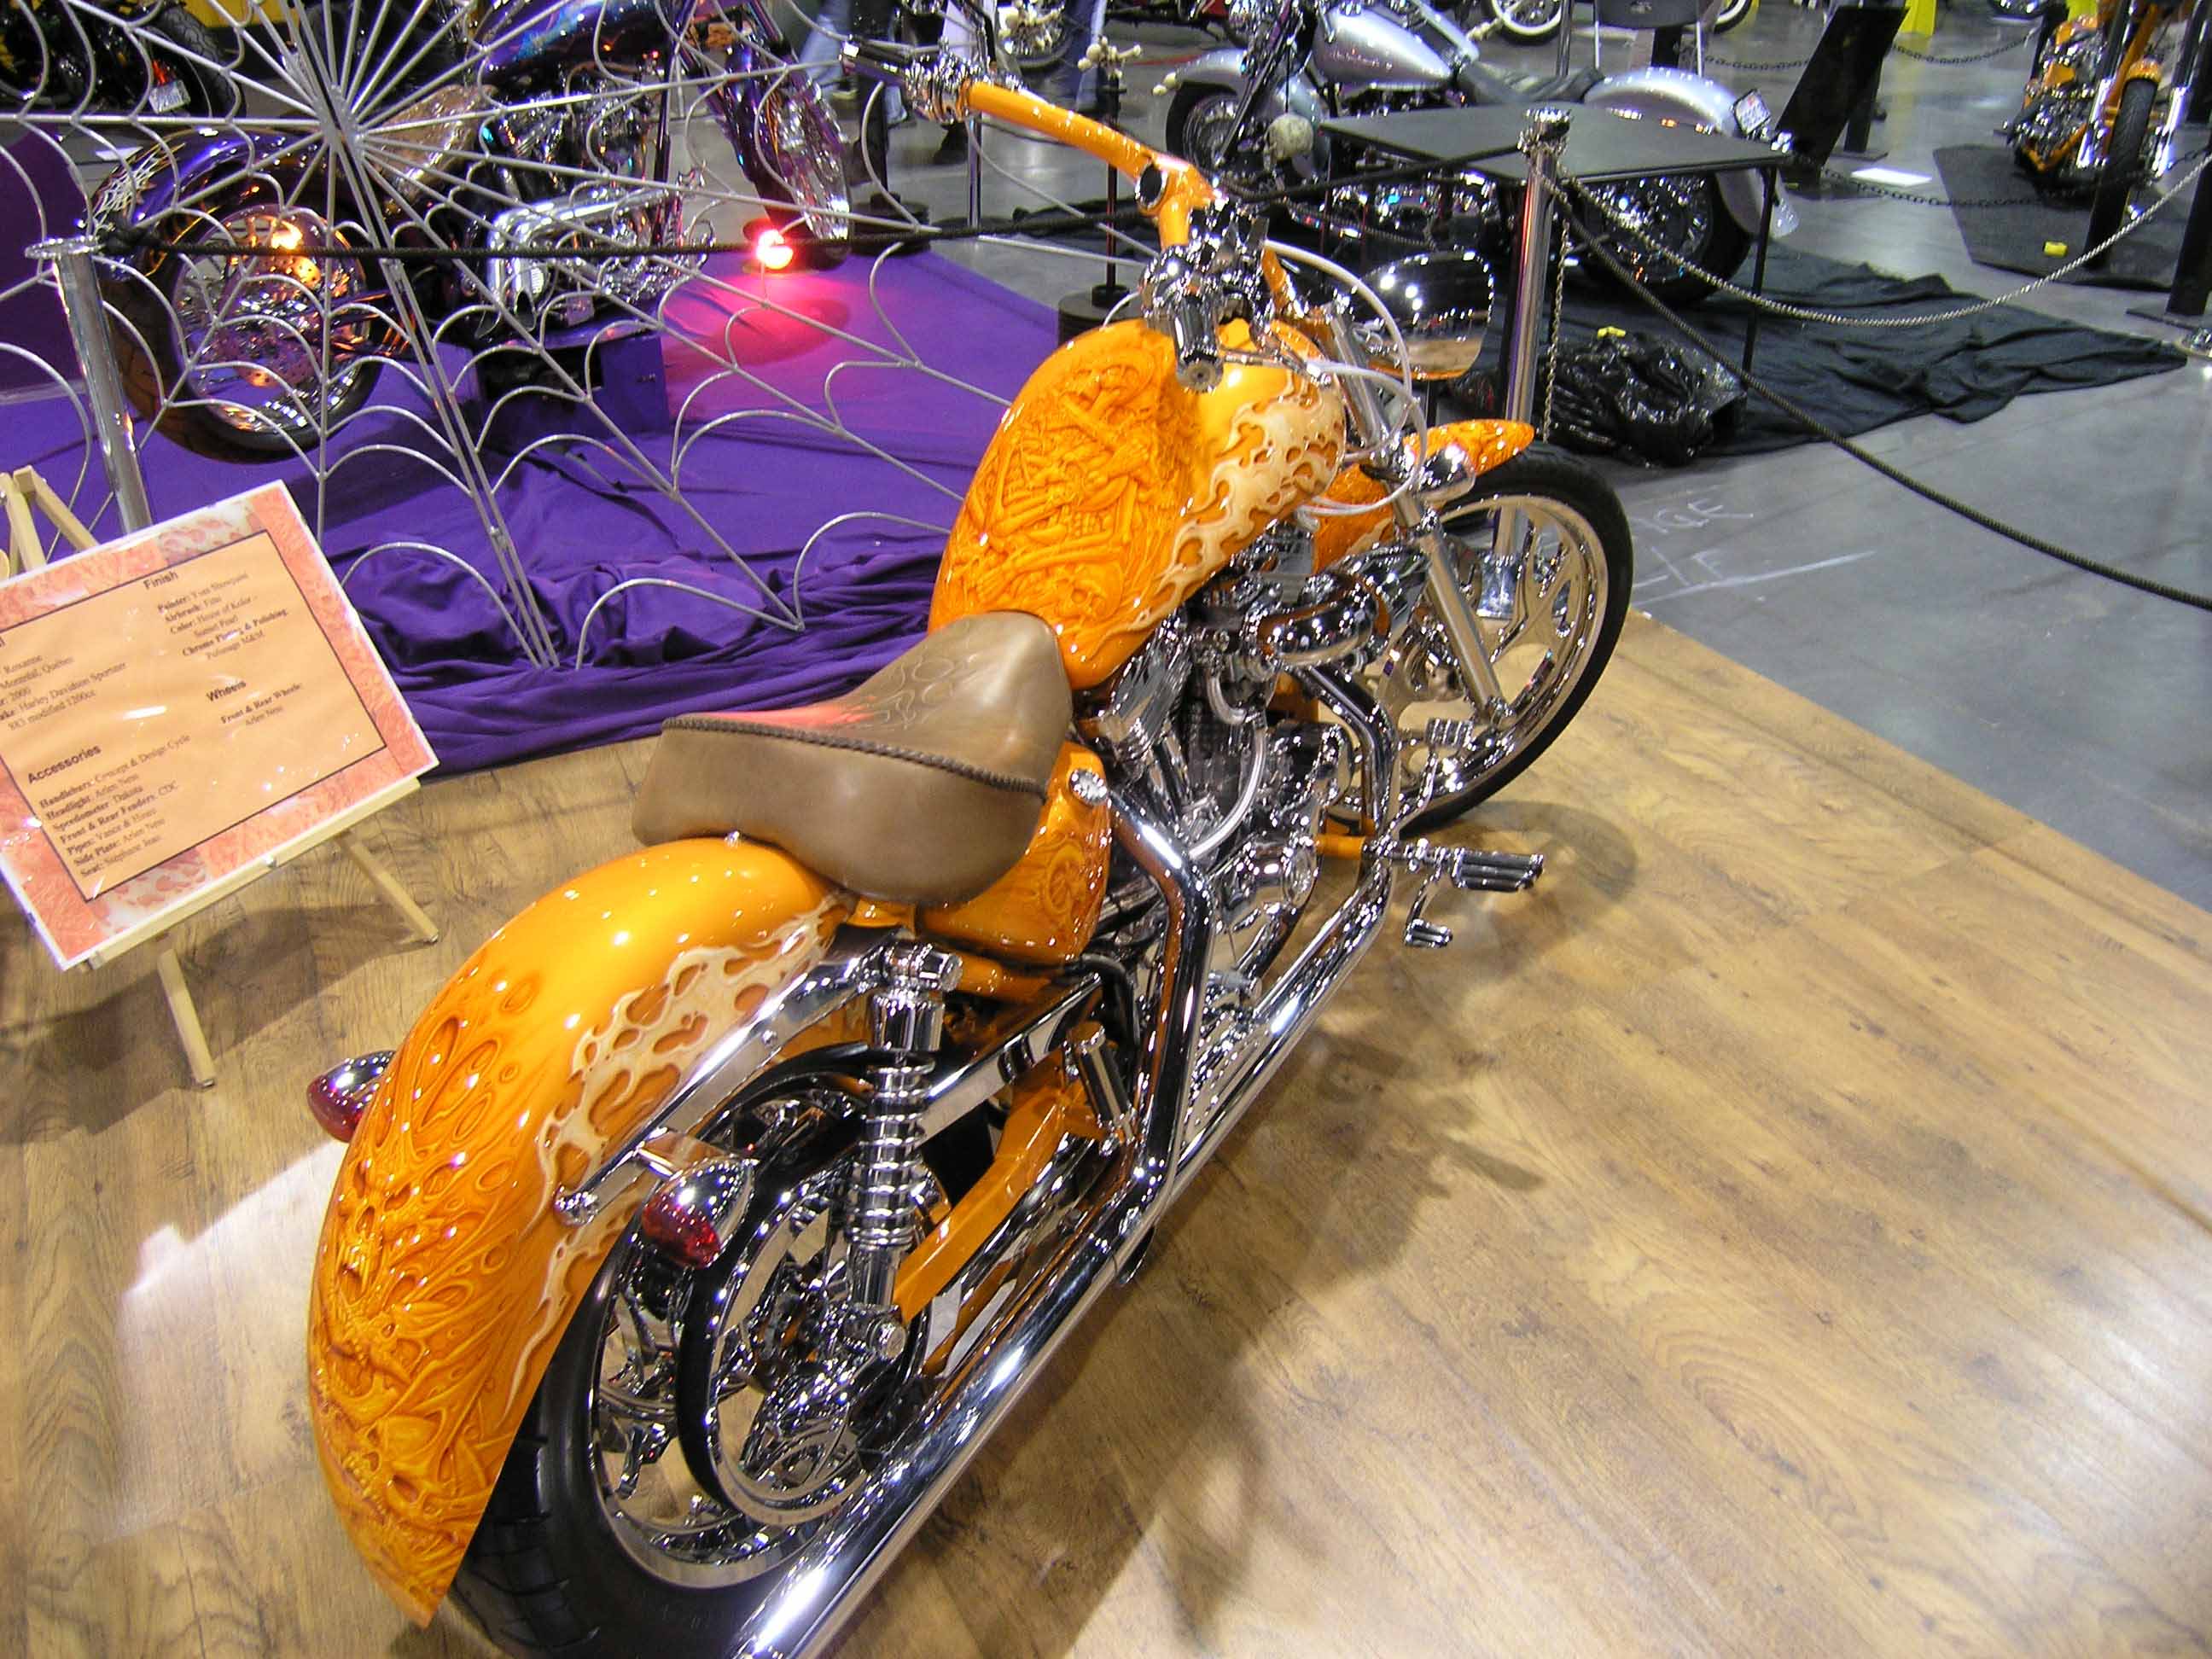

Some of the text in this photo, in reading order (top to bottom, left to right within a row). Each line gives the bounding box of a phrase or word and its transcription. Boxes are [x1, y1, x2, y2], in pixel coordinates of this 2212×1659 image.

[142, 569, 179, 590] Finish
[205, 677, 247, 702] Wheels
[219, 707, 244, 724] Front
[242, 703, 253, 713] &
[252, 693, 274, 709] Rear
[25, 742, 102, 784] Accessories
[59, 825, 87, 844] Front
[85, 821, 96, 831] &
[96, 808, 120, 826] Rear
